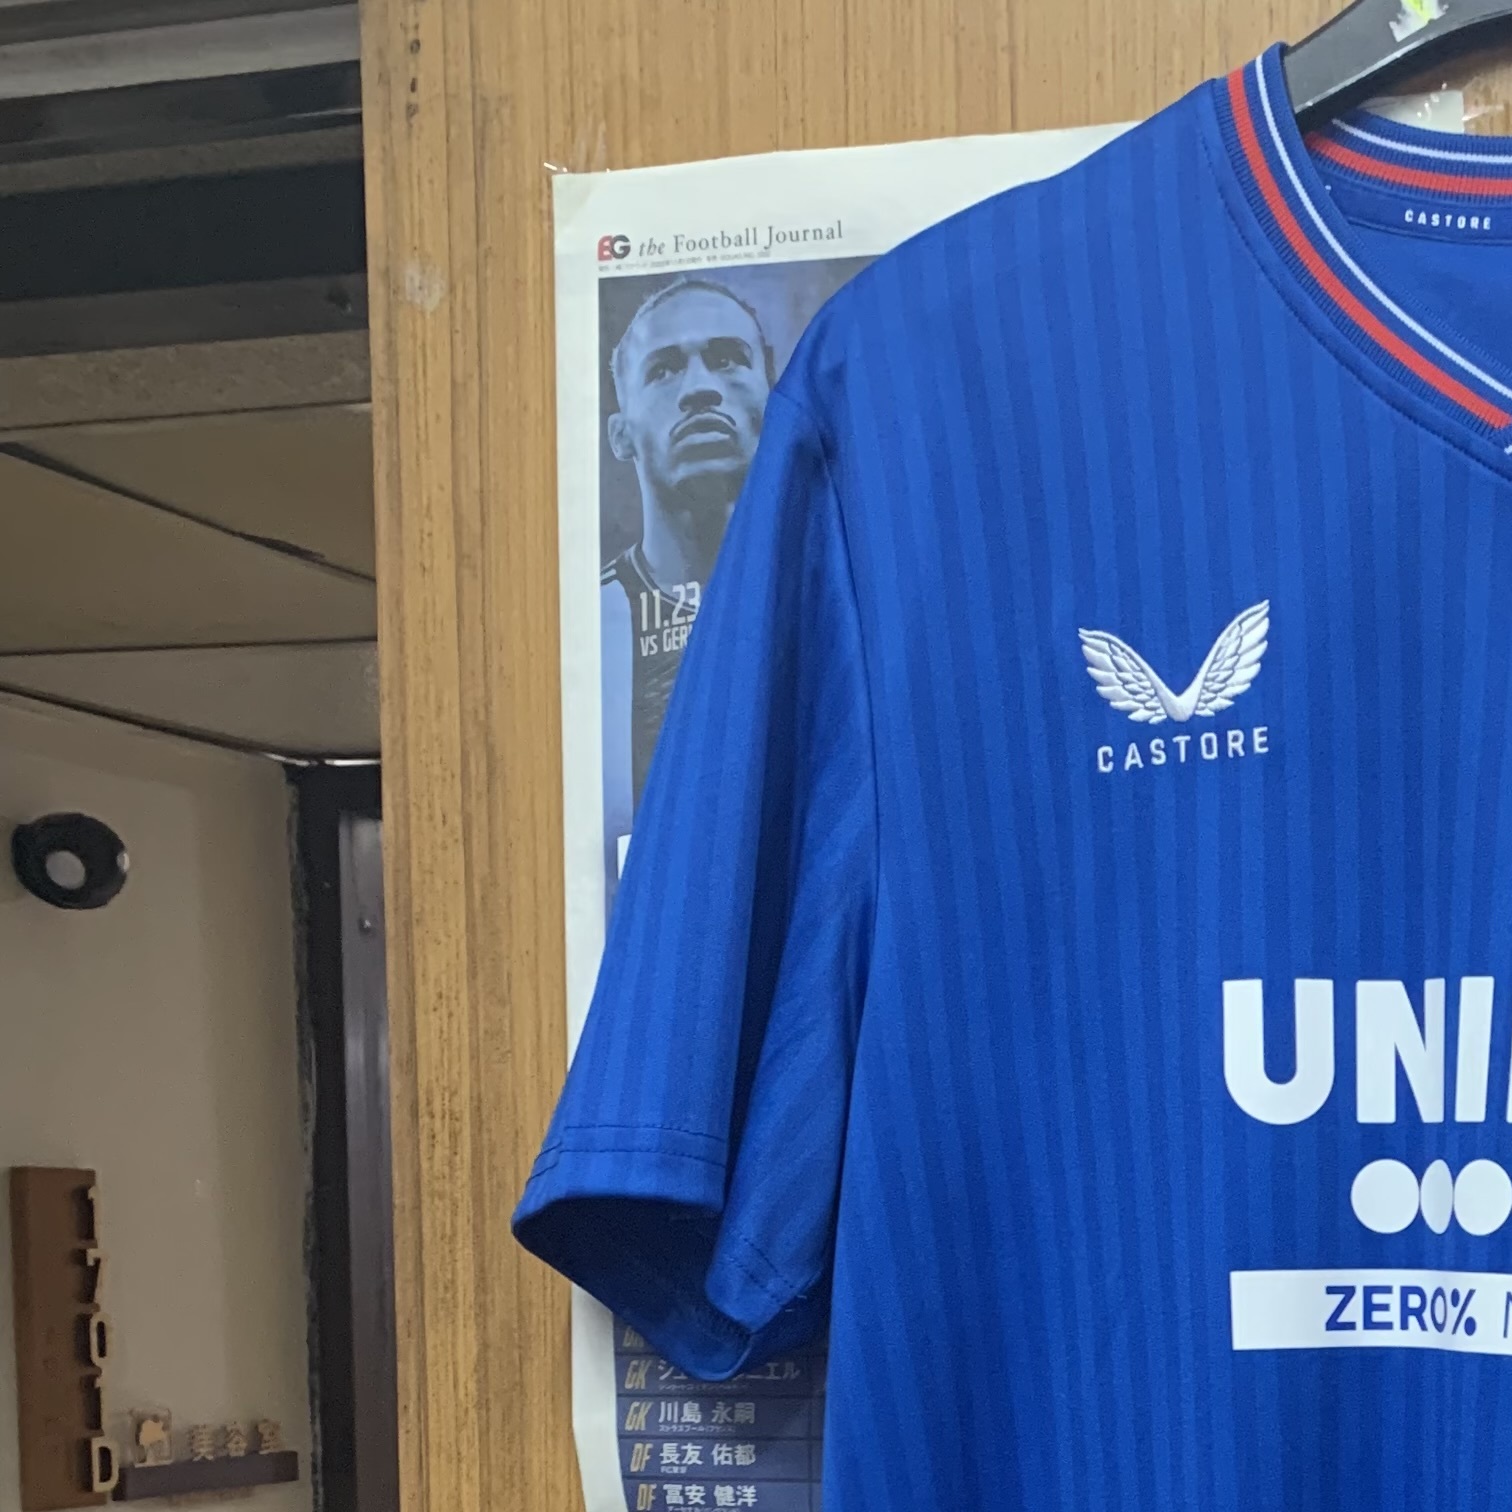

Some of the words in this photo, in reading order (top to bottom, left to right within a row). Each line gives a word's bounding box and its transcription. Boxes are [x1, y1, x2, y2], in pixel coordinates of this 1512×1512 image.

[1404, 209, 1492, 230] CASTORE
[638, 238, 666, 257] the
[673, 227, 758, 253] Football
[764, 220, 843, 250] Journal
[640, 581, 700, 632] 11.23
[640, 634, 658, 657] VS
[662, 622, 693, 653] GER
[1096, 726, 1269, 773] CASTORE
[625, 1401, 653, 1431] GK
[659, 1401, 703, 1424] 川島
[711, 1402, 756, 1425] 永嗣
[630, 1443, 653, 1472] DF
[659, 1442, 704, 1465] 長友
[711, 1443, 757, 1466] 佑都
[637, 1483, 658, 1511] DF
[713, 1484, 758, 1507] 健洋
